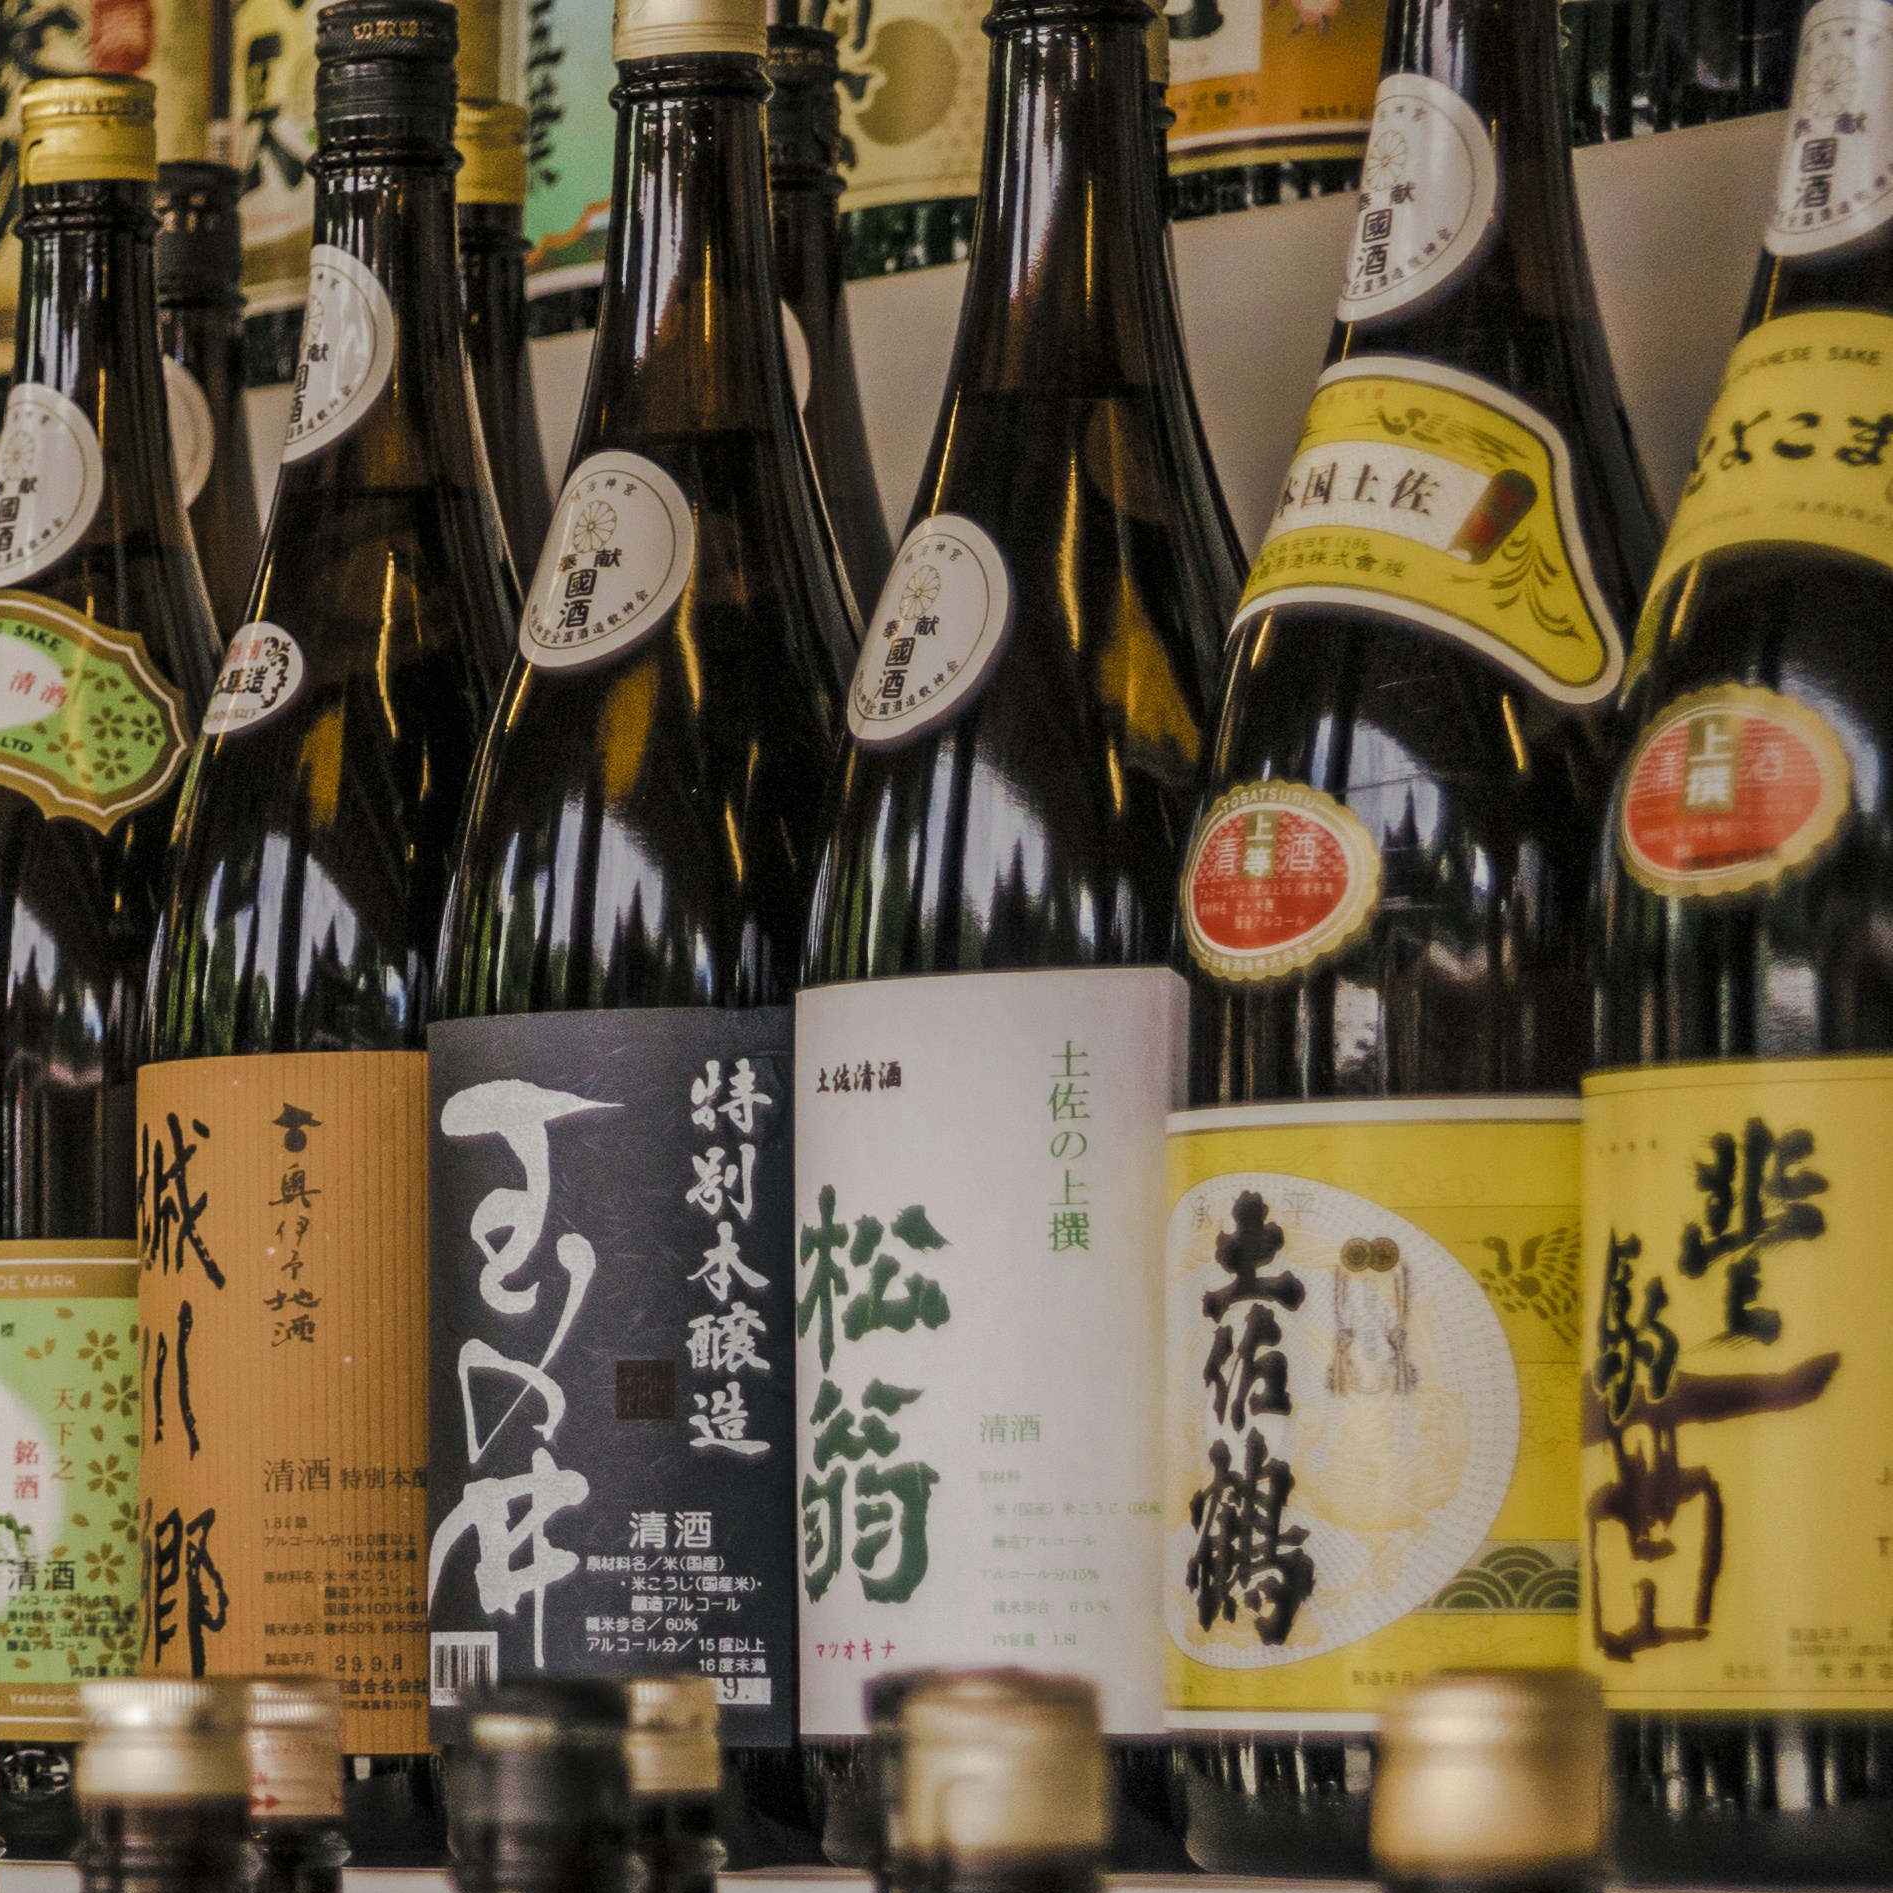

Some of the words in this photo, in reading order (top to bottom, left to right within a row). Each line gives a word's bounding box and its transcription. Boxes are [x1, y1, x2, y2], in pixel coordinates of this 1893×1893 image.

[557, 568, 599, 630] 國酒
[874, 636, 917, 700] 國酒
[9, 668, 70, 710] 清酒
[816, 1059, 903, 1094] 土佐清酒
[1046, 1039, 1092, 1253] 土佐の上撰
[685, 1057, 774, 1458] 特別本醸造
[978, 1412, 1043, 1445] 清酒
[1184, 1190, 1317, 1646] 土佐鶴
[264, 1455, 332, 1494] 清酒
[628, 1510, 713, 1550] 清酒
[6, 1559, 77, 1592] 清酒
[630, 1595, 742, 1613] 醸造アルコール
[814, 1636, 899, 1663] マツオキナ
